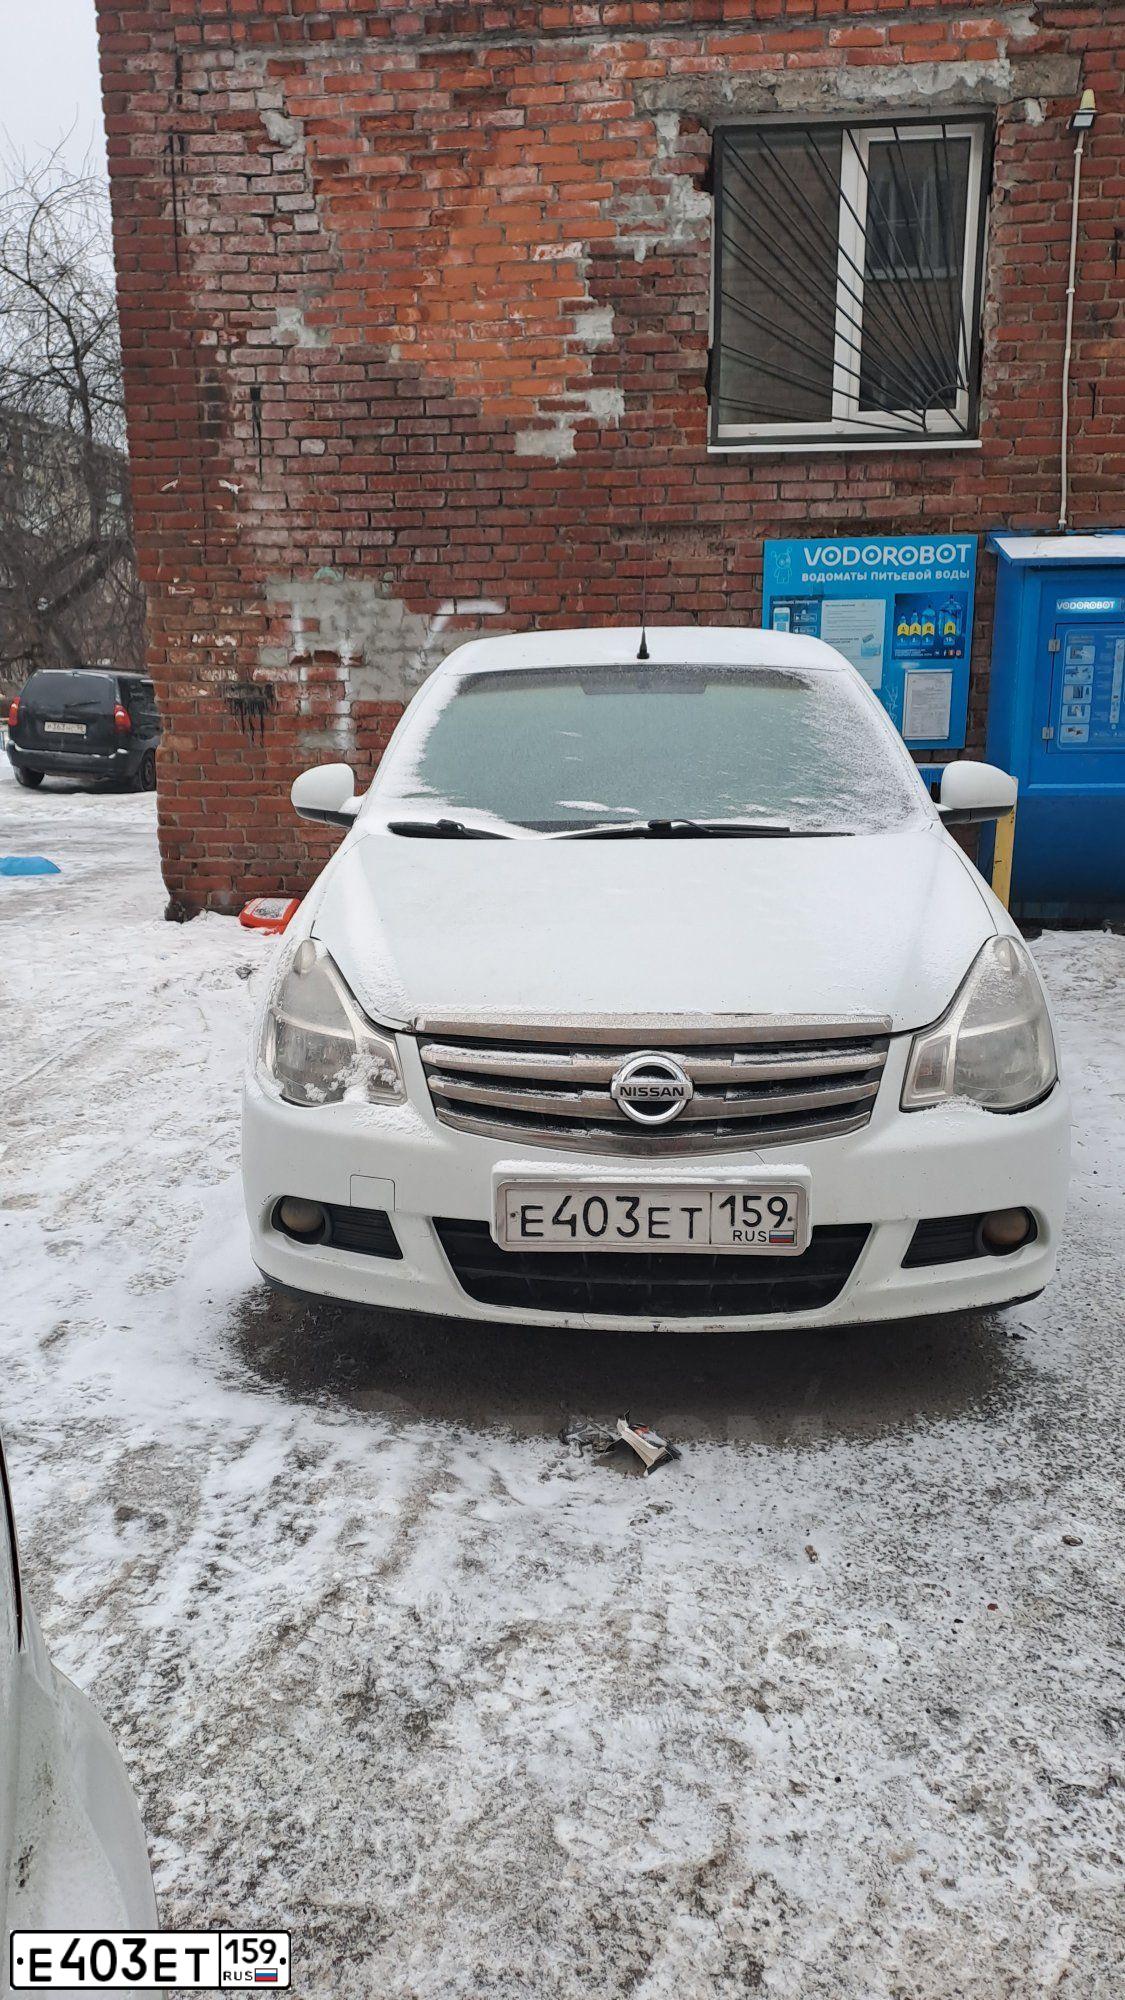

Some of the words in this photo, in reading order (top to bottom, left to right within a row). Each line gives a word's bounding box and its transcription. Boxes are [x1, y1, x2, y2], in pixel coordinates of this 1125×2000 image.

[803, 543, 972, 567] VODOROBOT
[801, 571, 868, 583] ВОДОМАТЫ
[870, 568, 932, 581] ПИТЬЕВОЙ
[935, 569, 970, 581] ВОДЫ
[1056, 601, 1115, 610] VODOROBOT
[620, 1086, 684, 1097] NISSAN
[718, 1195, 789, 1228] 159
[732, 1230, 767, 1243] RUS
